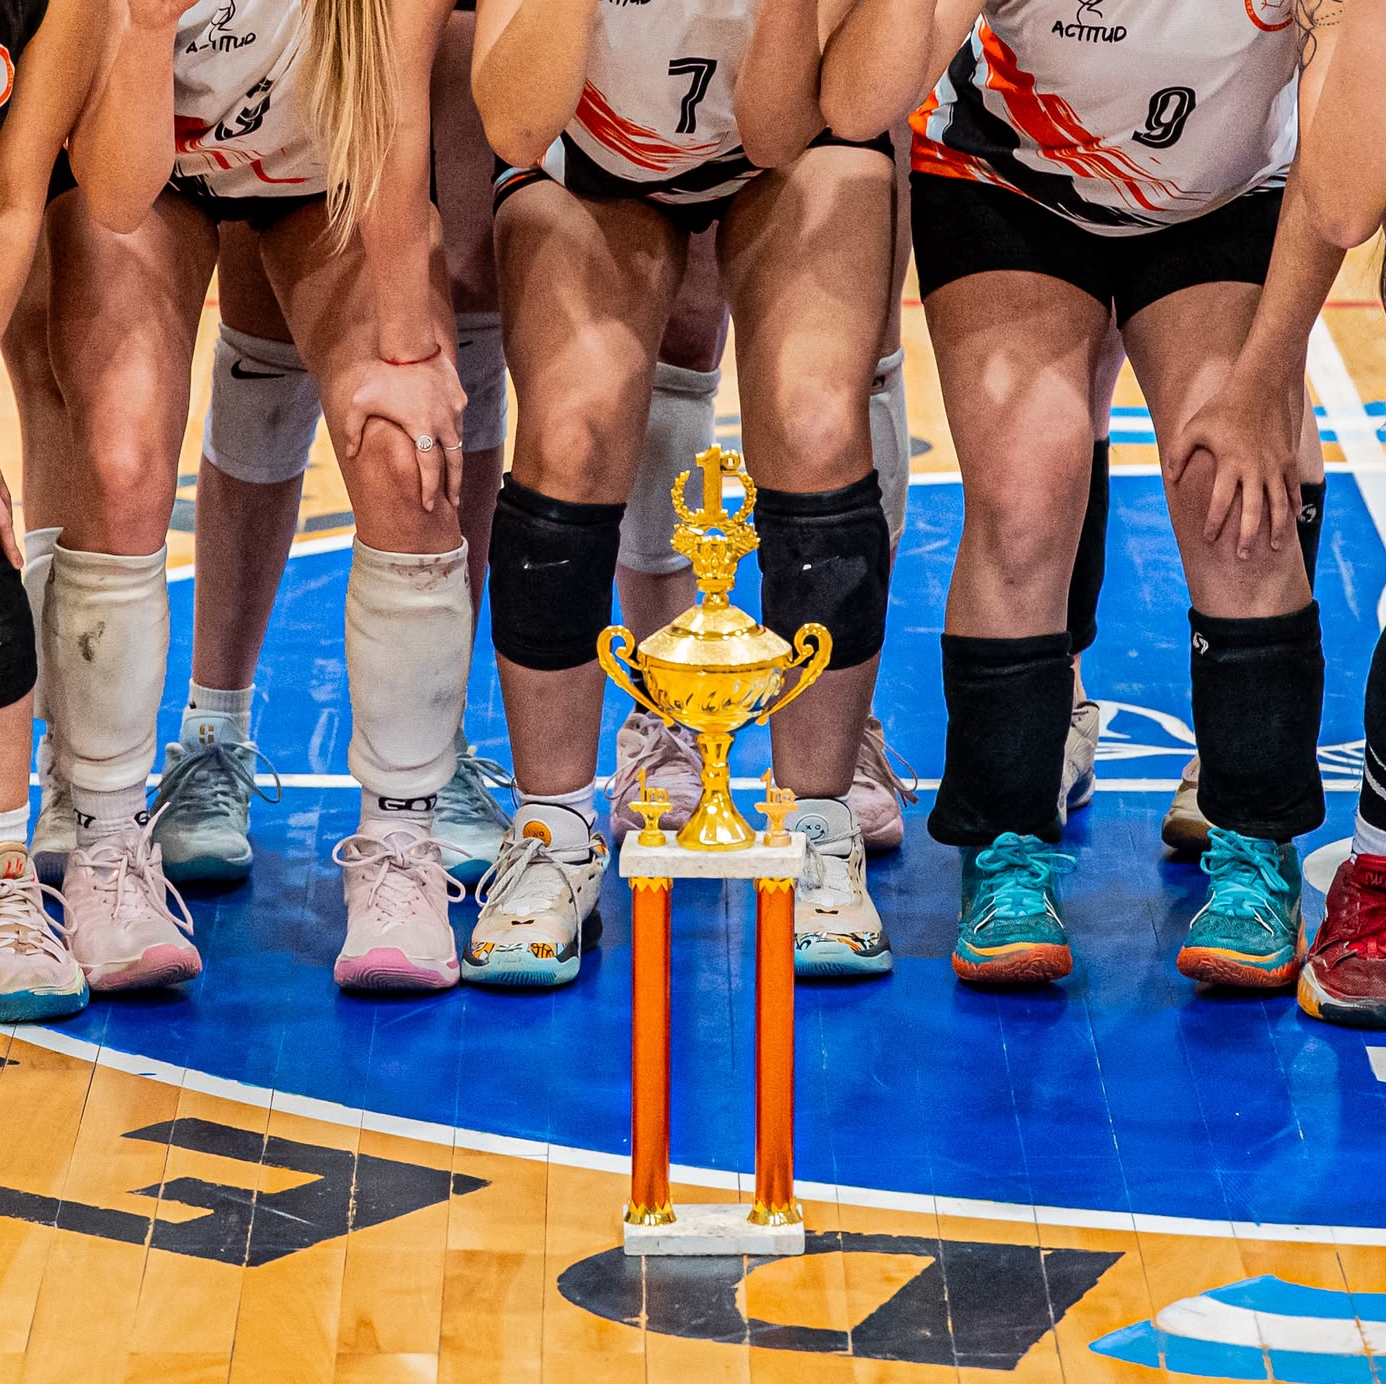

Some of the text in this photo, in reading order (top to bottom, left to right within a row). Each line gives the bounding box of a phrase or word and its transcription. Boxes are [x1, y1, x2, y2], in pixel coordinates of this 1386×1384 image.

[1052, 21, 1127, 43] ACTITUD
[668, 57, 717, 133] 7
[1132, 86, 1196, 149] 9
